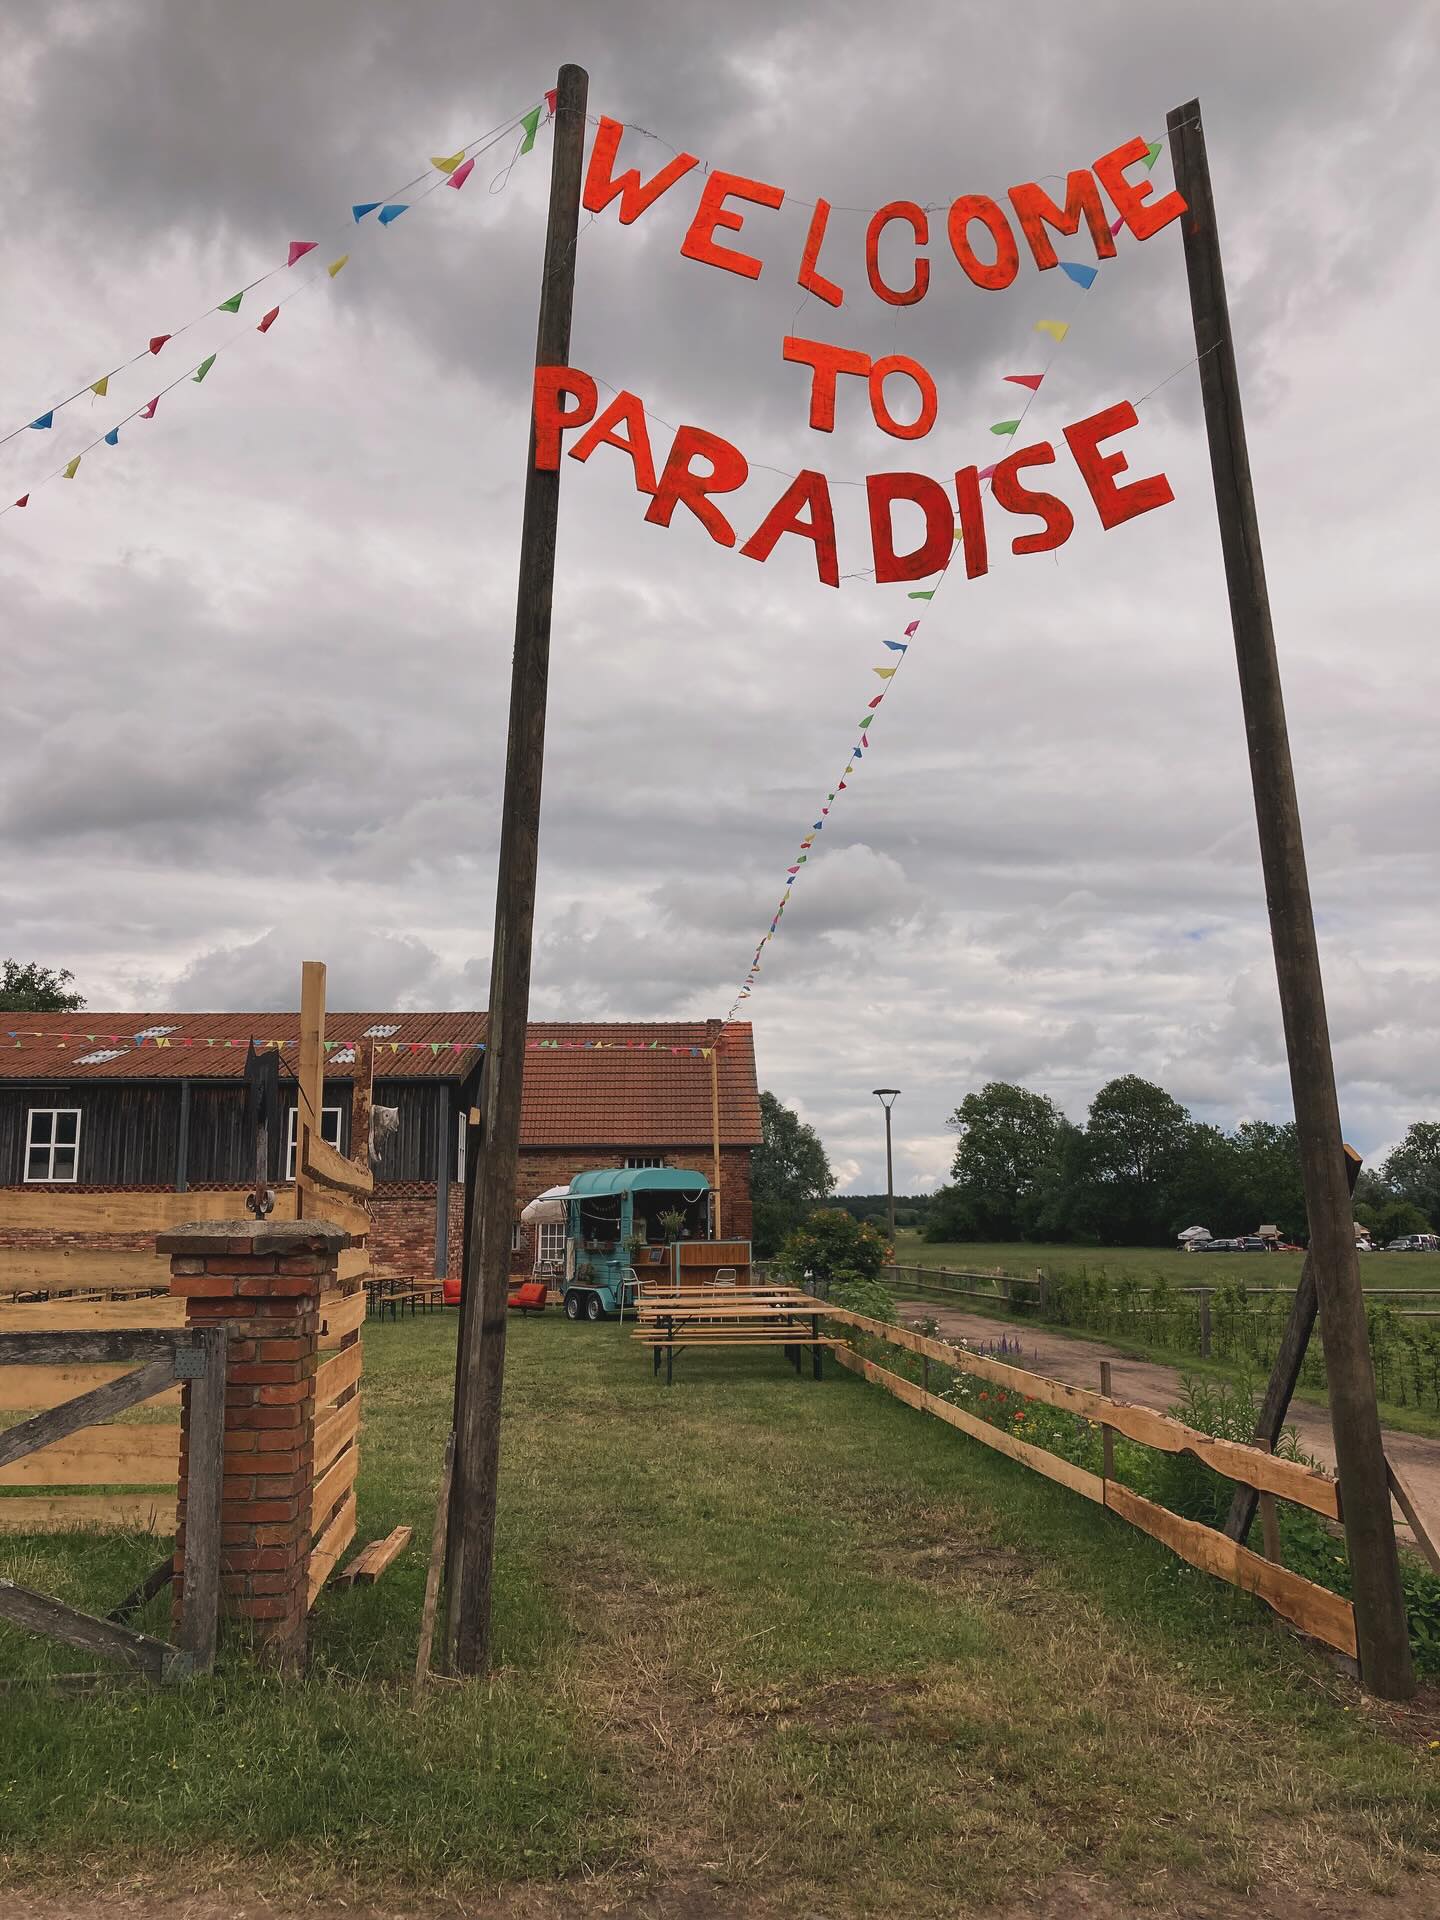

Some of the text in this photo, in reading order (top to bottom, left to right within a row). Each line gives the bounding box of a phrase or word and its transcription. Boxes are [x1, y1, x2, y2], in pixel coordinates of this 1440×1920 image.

[582, 115, 1189, 307] WELCOME
[533, 365, 1175, 588] PARADISE
[783, 336, 938, 440] TO
